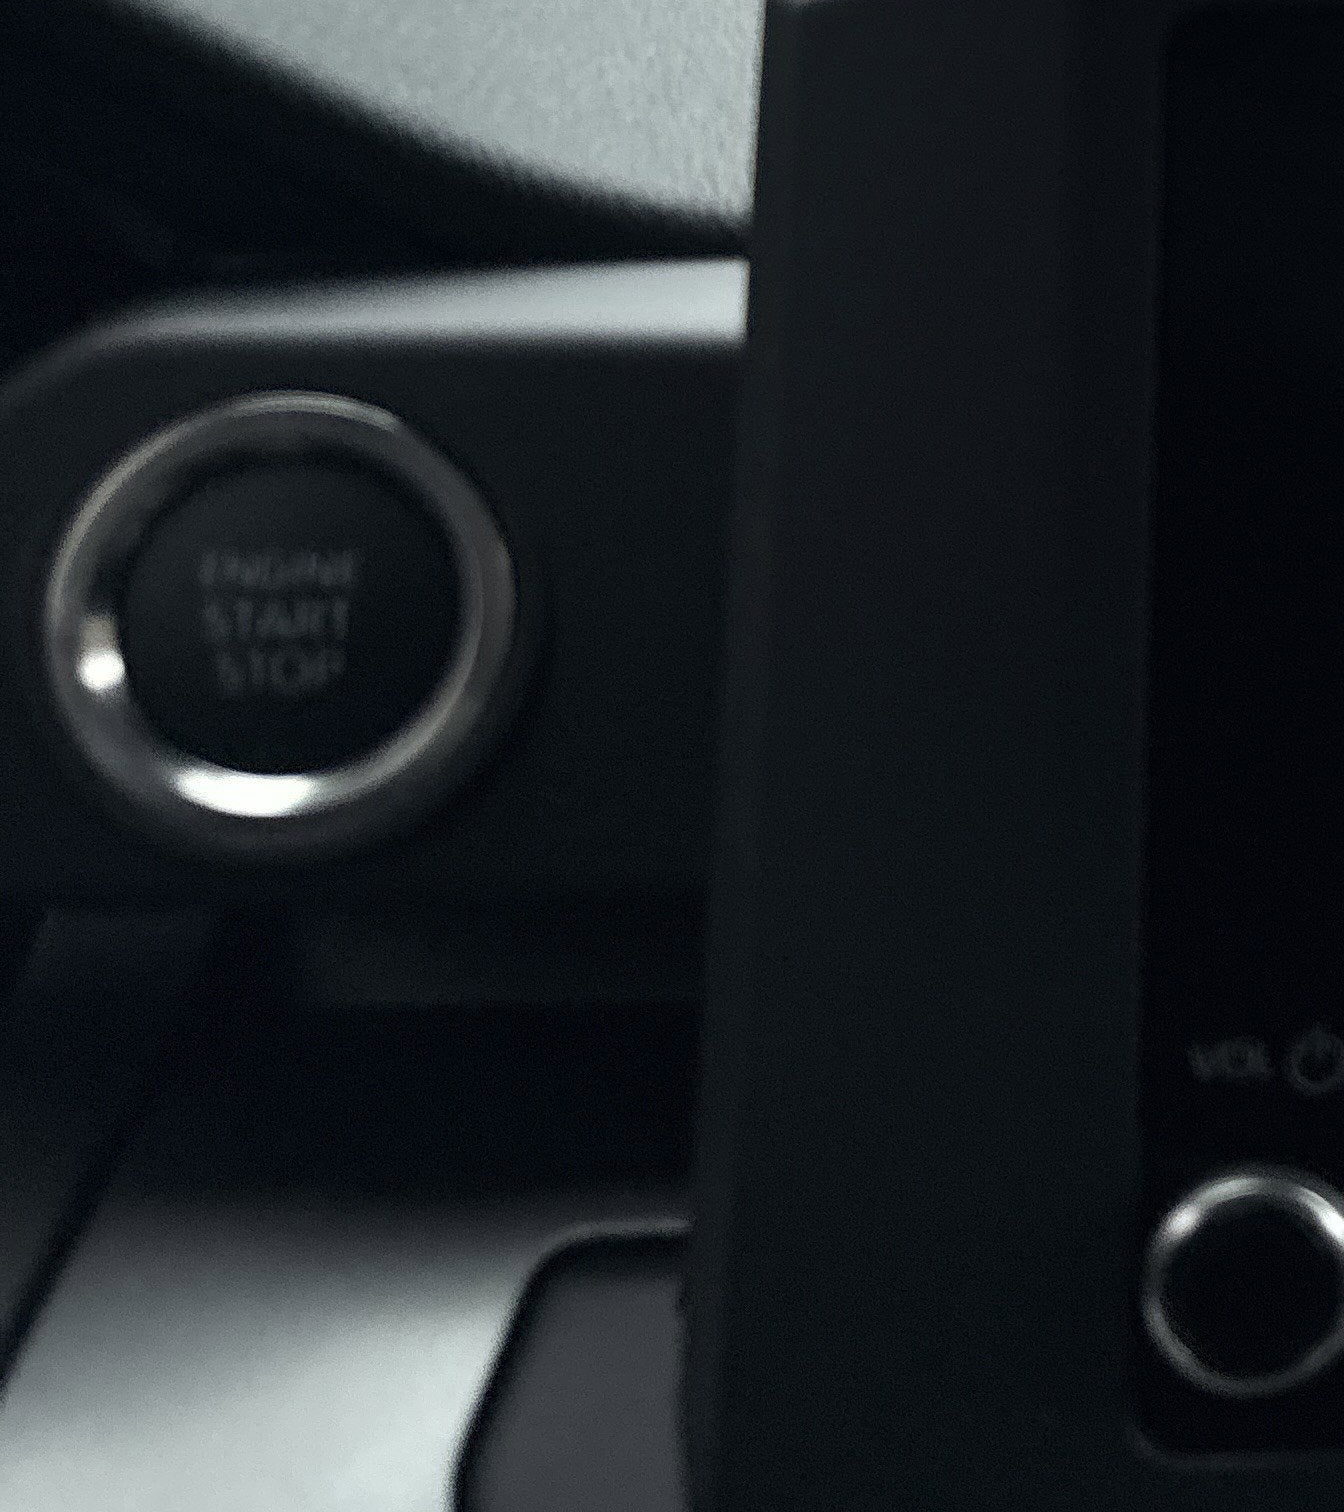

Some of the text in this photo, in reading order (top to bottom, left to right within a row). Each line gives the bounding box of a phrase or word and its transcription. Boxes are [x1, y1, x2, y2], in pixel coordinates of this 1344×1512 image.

[202, 600, 350, 641] START
[216, 648, 345, 696] STOP
[1186, 1038, 1272, 1082] VOL
